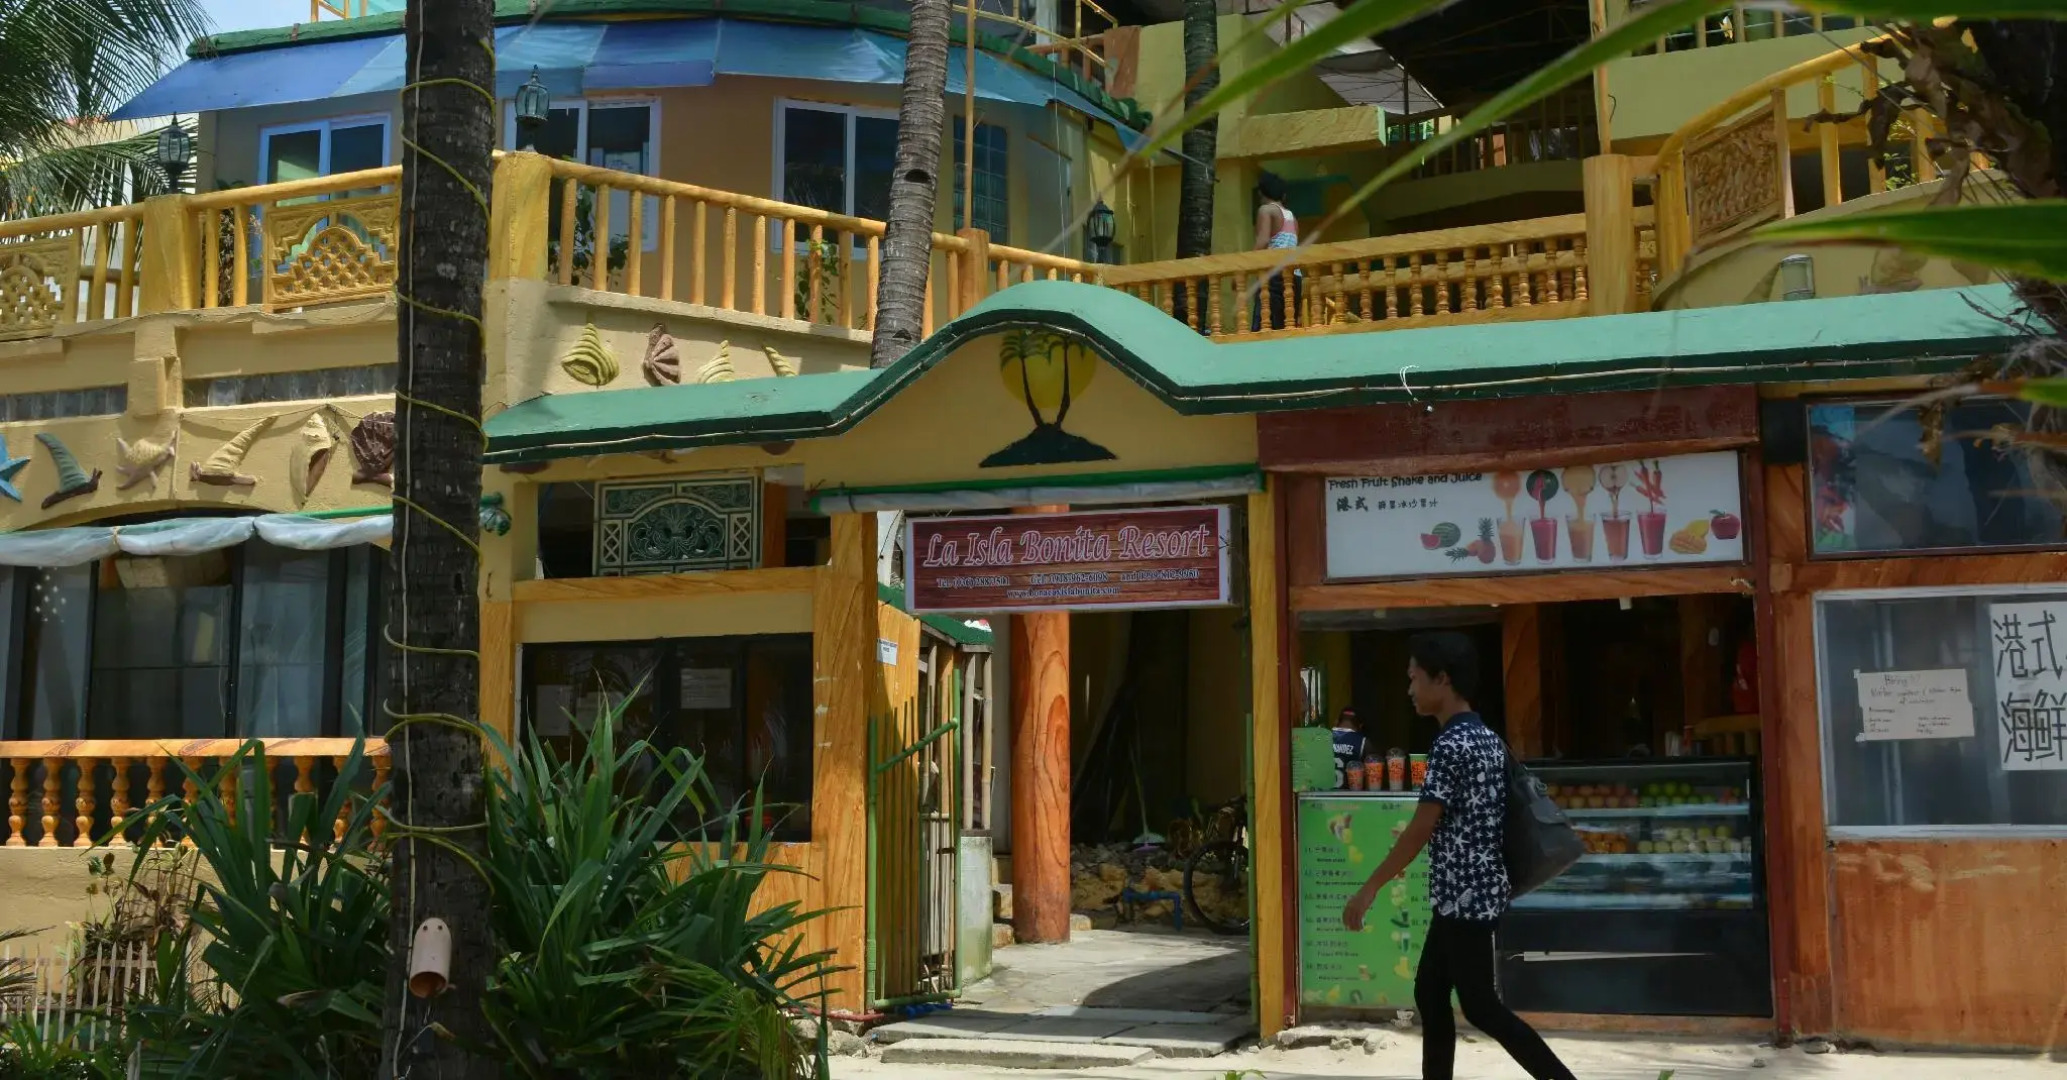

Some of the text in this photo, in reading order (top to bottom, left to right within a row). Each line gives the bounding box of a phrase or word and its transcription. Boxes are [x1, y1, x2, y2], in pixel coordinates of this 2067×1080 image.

[1328, 472, 1483, 491] Fresh Fruit Shake and Juice
[922, 523, 1210, 567] La Isla Bonita Resort
[1992, 610, 2063, 680] 港式
